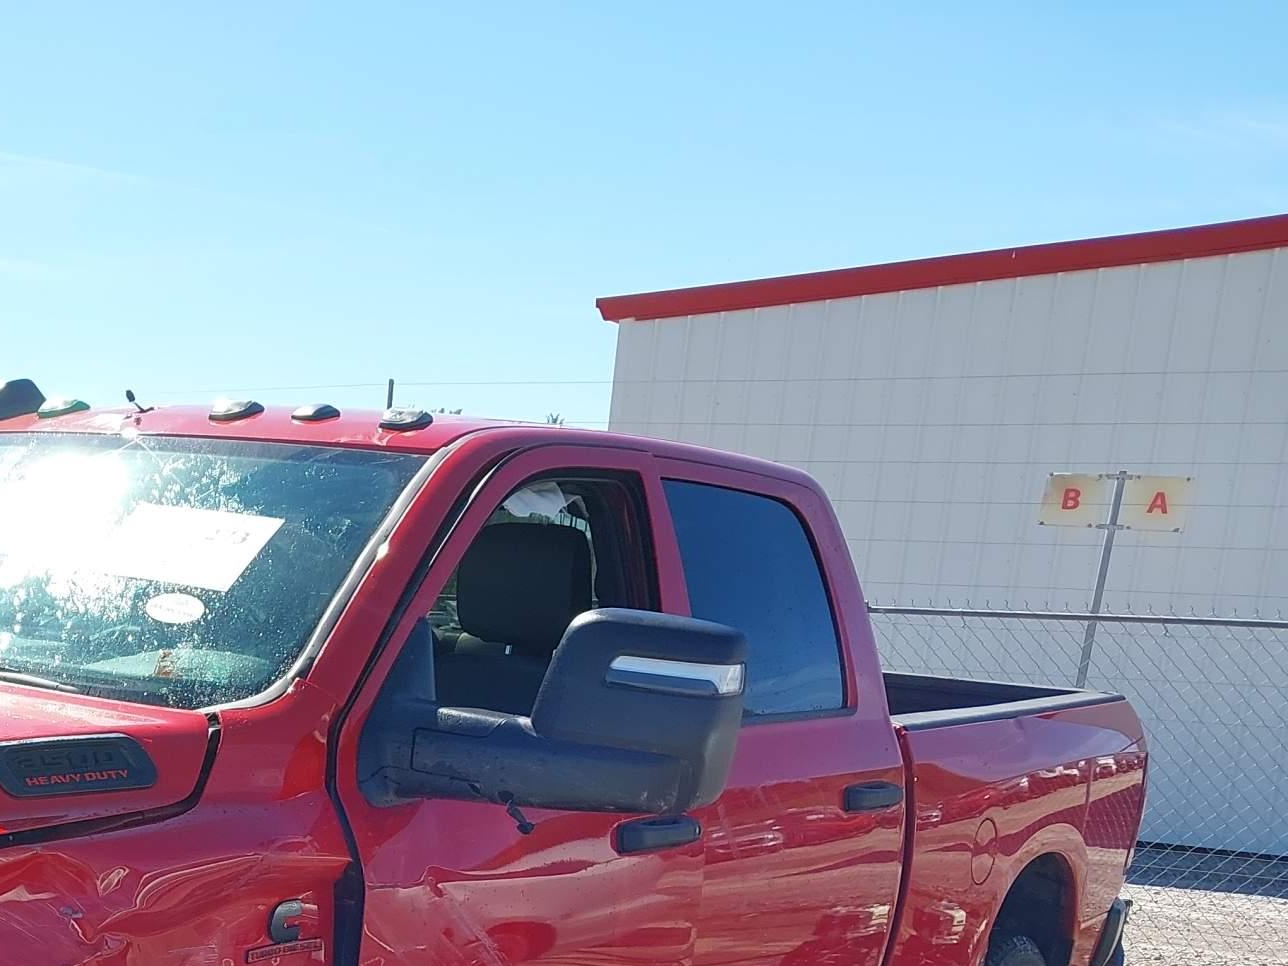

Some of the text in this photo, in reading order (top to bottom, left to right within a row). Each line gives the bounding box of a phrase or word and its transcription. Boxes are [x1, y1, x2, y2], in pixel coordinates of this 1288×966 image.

[1061, 488, 1081, 510] B
[1146, 491, 1168, 514] A
[25, 769, 128, 786] HEAVY DUTY
